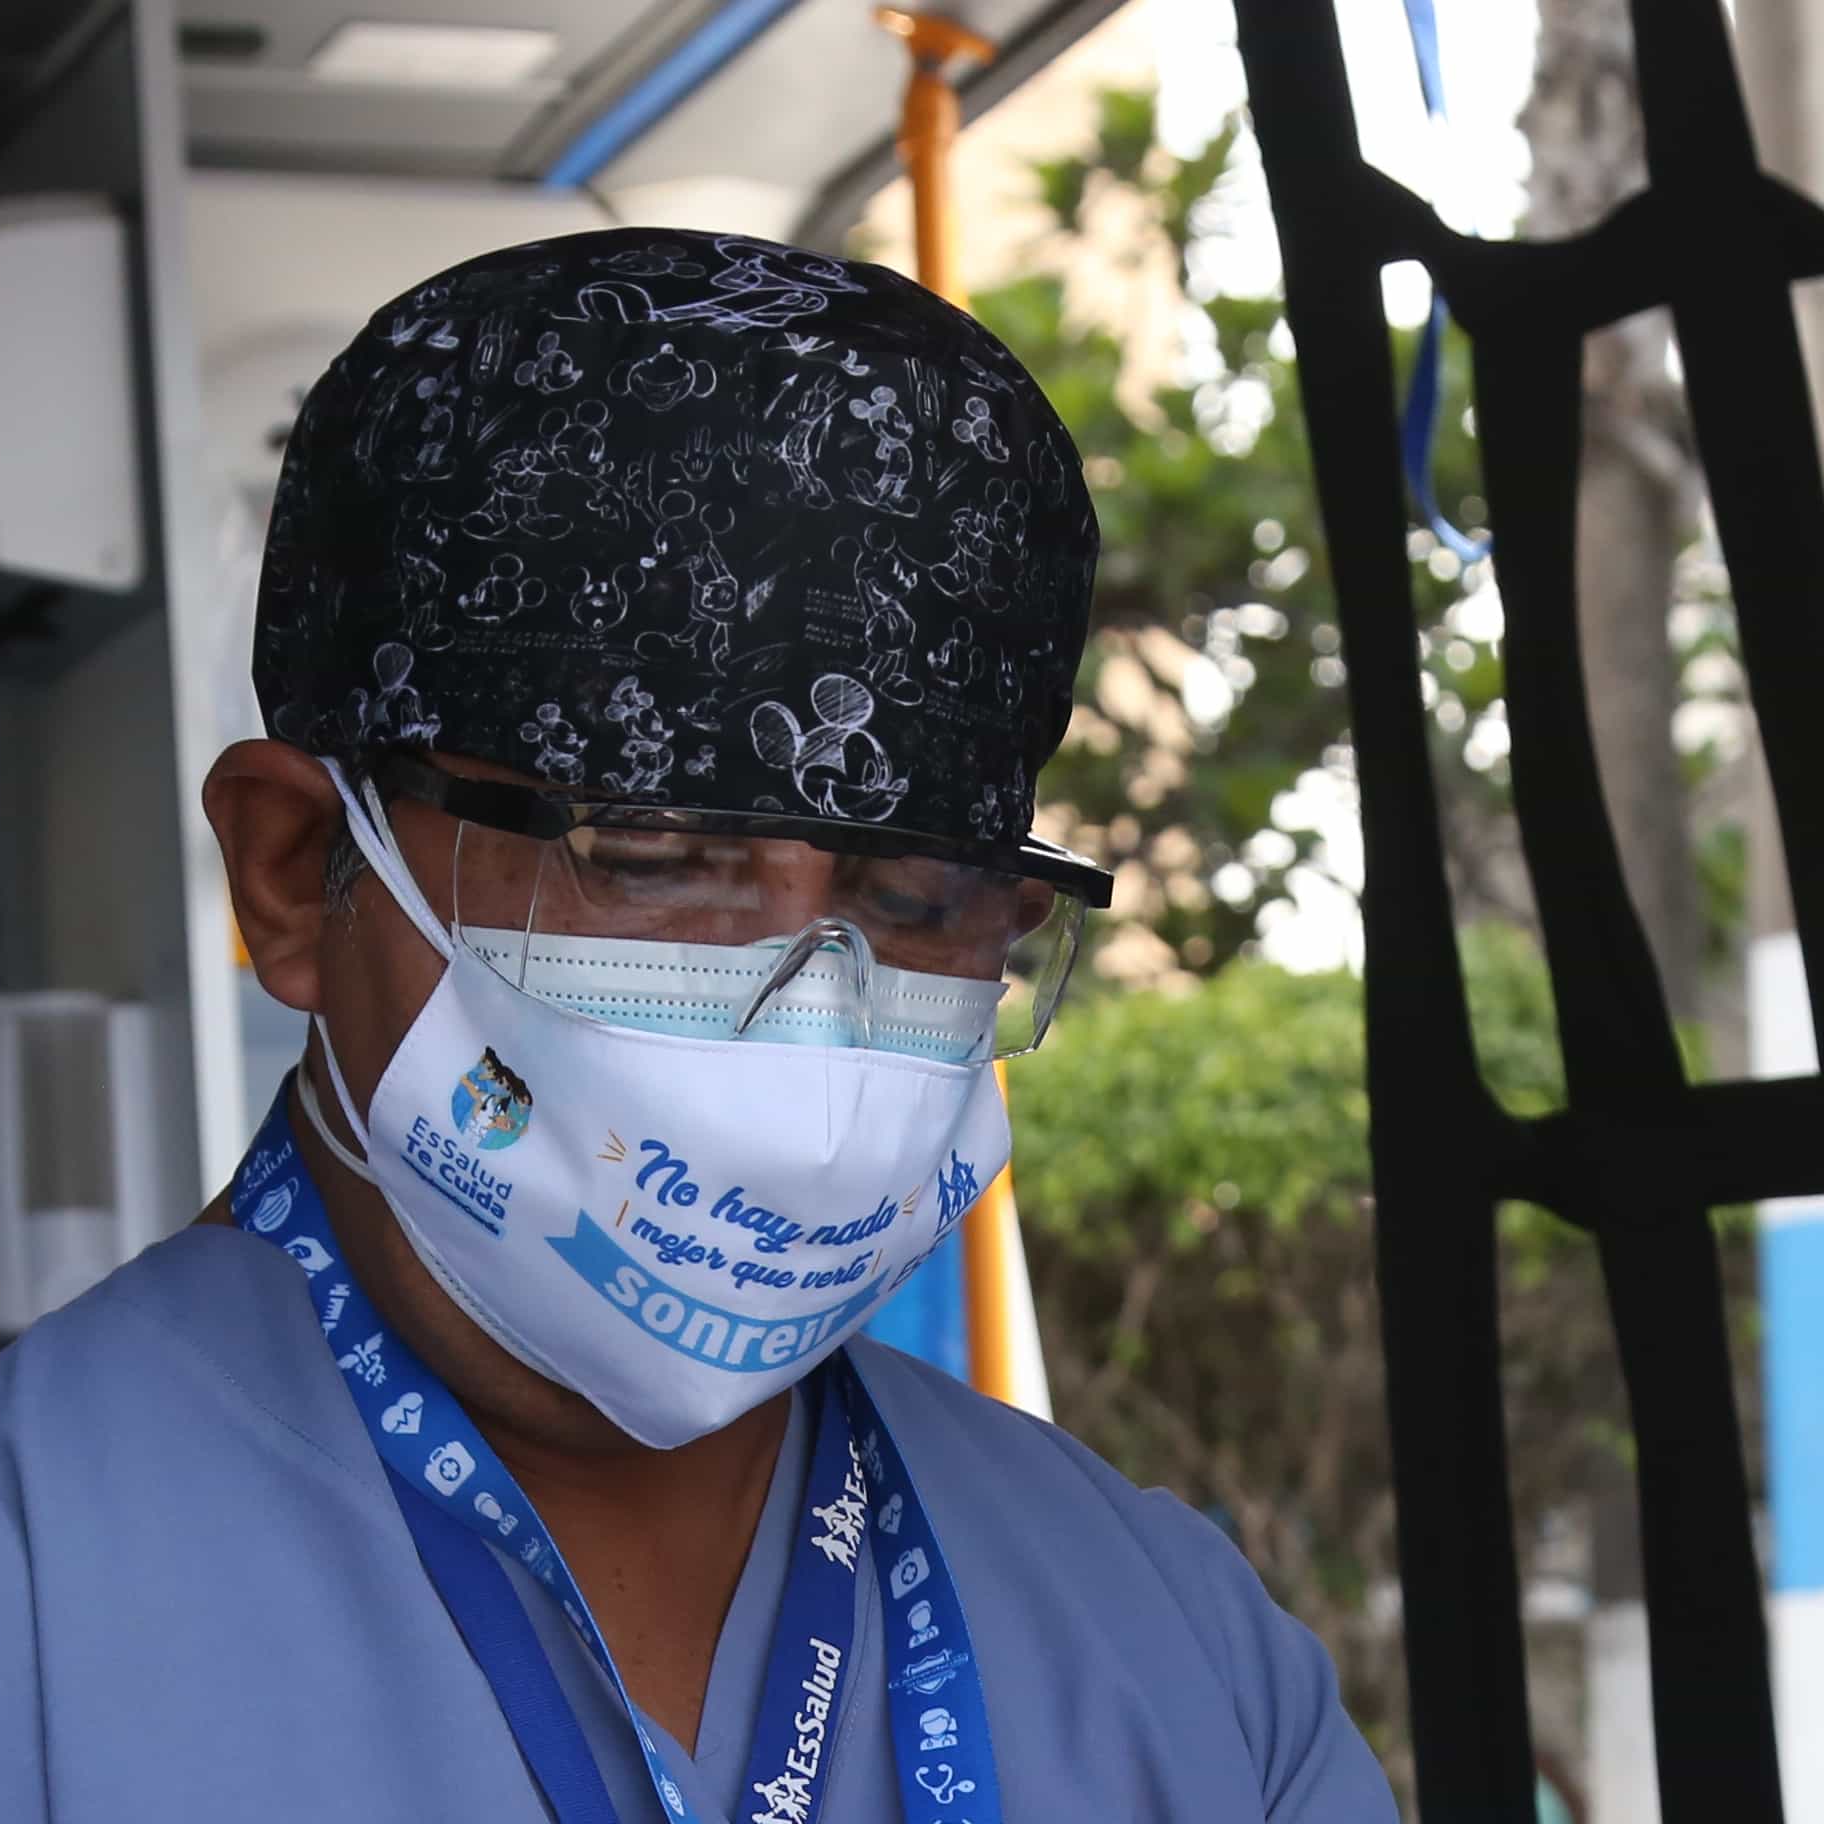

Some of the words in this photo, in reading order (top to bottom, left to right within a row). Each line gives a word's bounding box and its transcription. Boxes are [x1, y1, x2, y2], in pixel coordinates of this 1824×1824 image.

[405, 1133, 433, 1168] Te
[438, 1163, 506, 1220] Cuida
[412, 1114, 512, 1200] EsSalud
[636, 1138, 700, 1207] No
[709, 1185, 804, 1254] hay
[805, 1195, 898, 1246] nada
[630, 1217, 729, 1266] mejor
[730, 1260, 797, 1289] que
[786, 1637, 842, 1779] EsSalud
